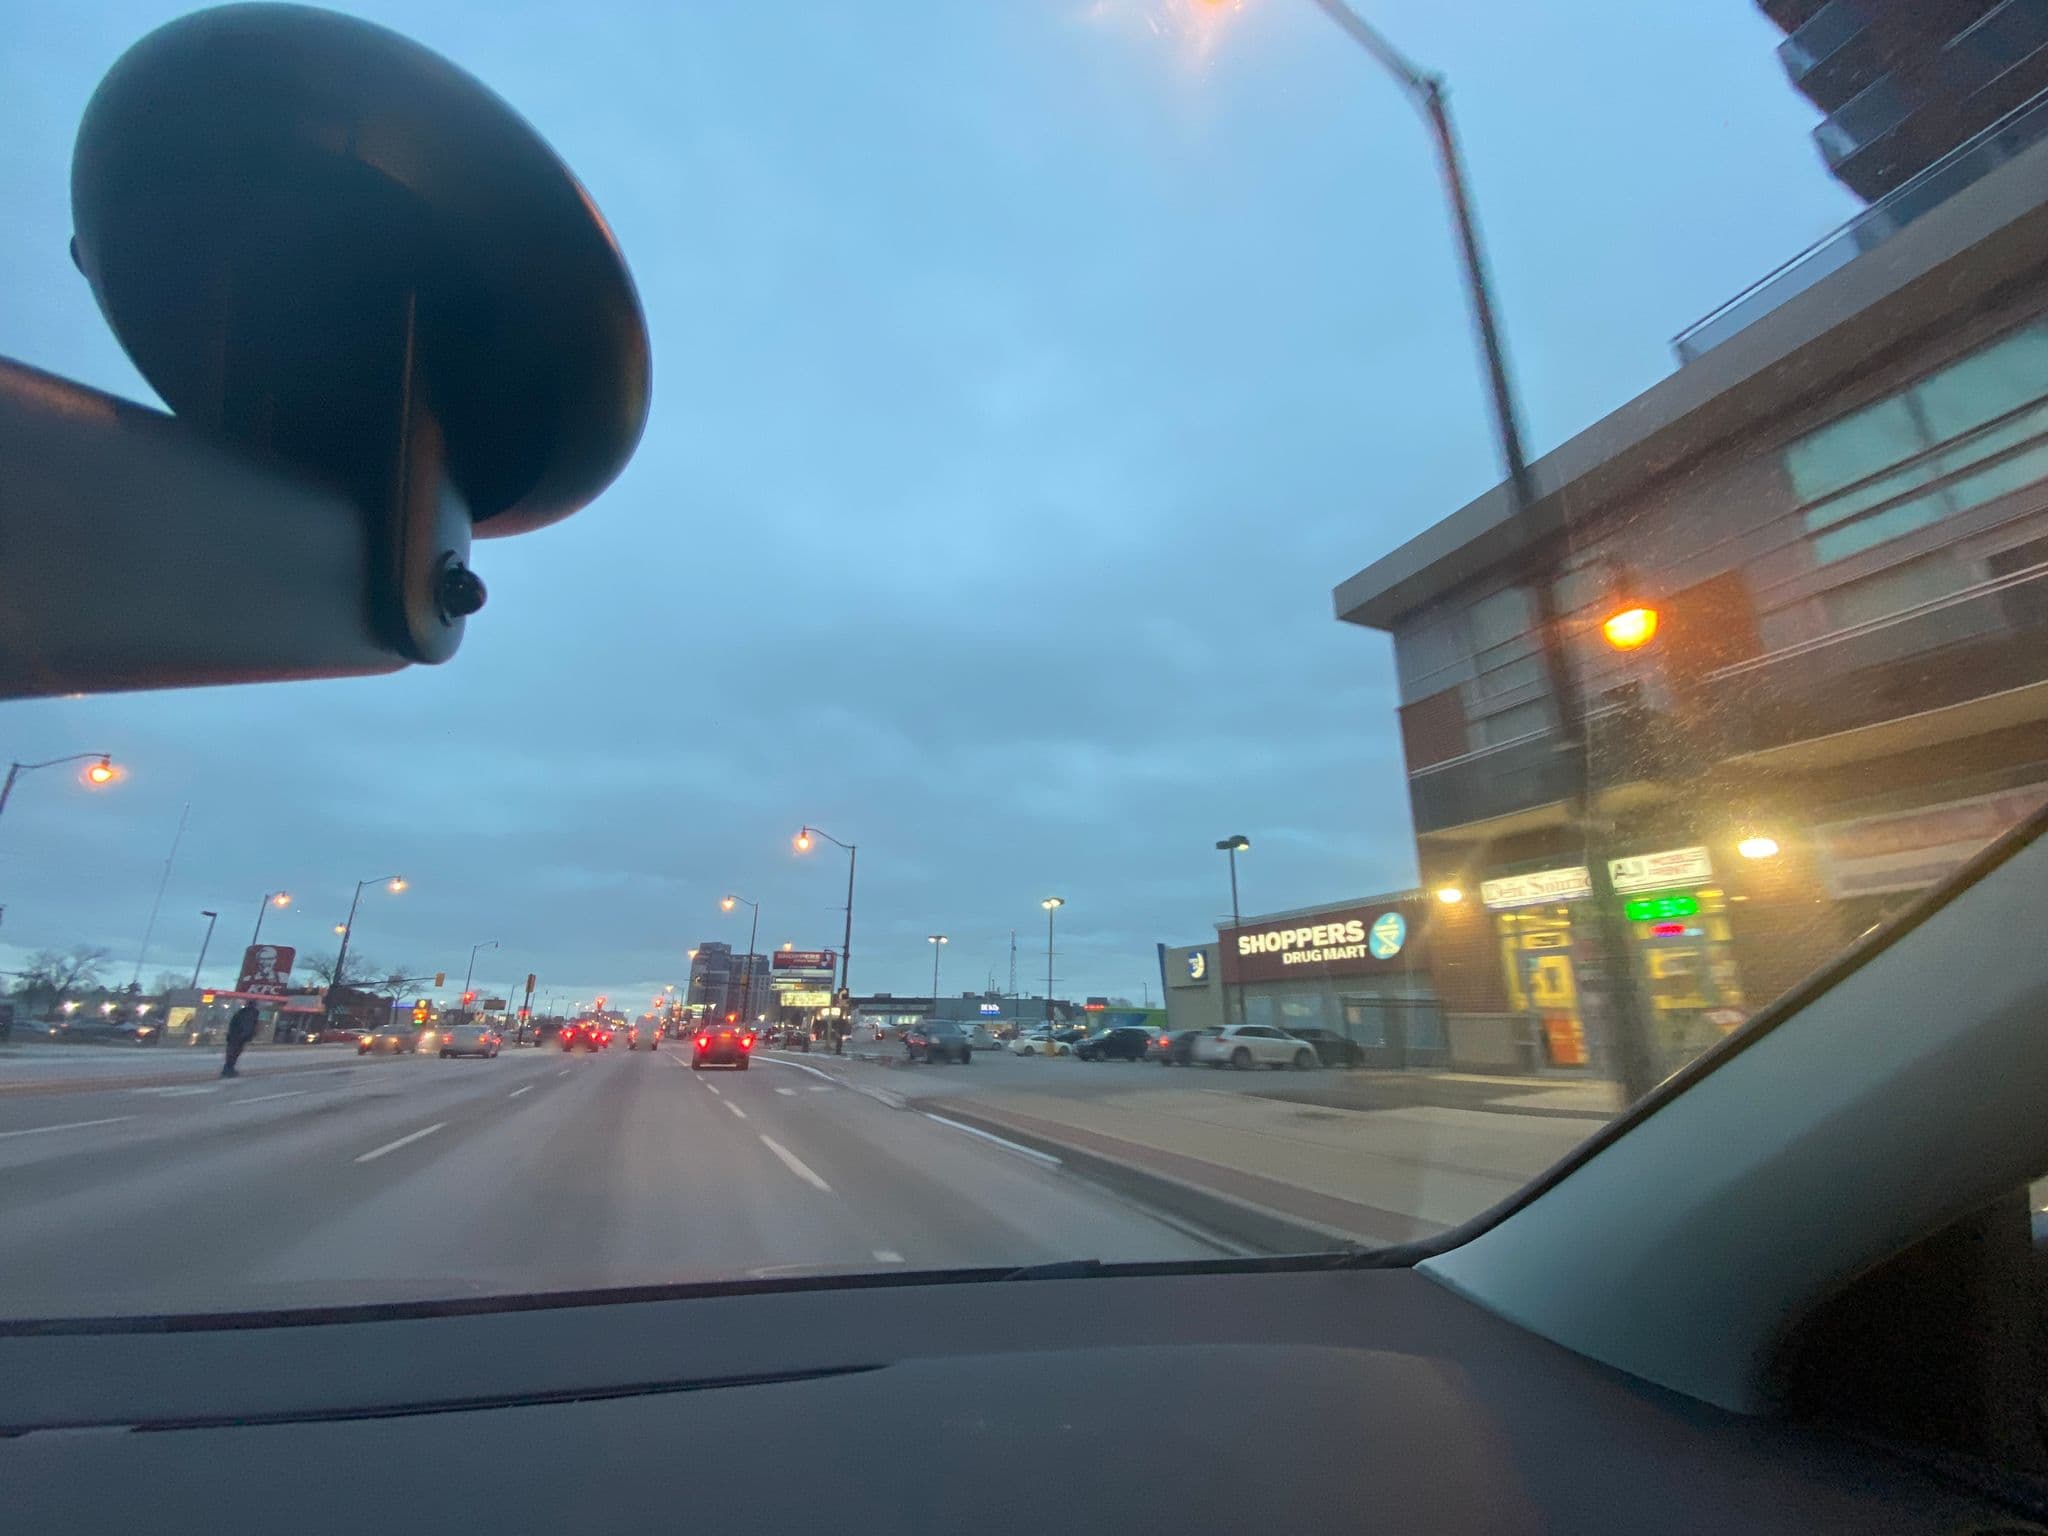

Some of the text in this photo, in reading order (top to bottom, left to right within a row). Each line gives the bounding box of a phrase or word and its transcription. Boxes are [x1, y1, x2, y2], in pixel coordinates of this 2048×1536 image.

[1238, 920, 1365, 955] SHOPPERS
[1282, 944, 1367, 965] DRUG MART
[247, 984, 283, 995] KFC
